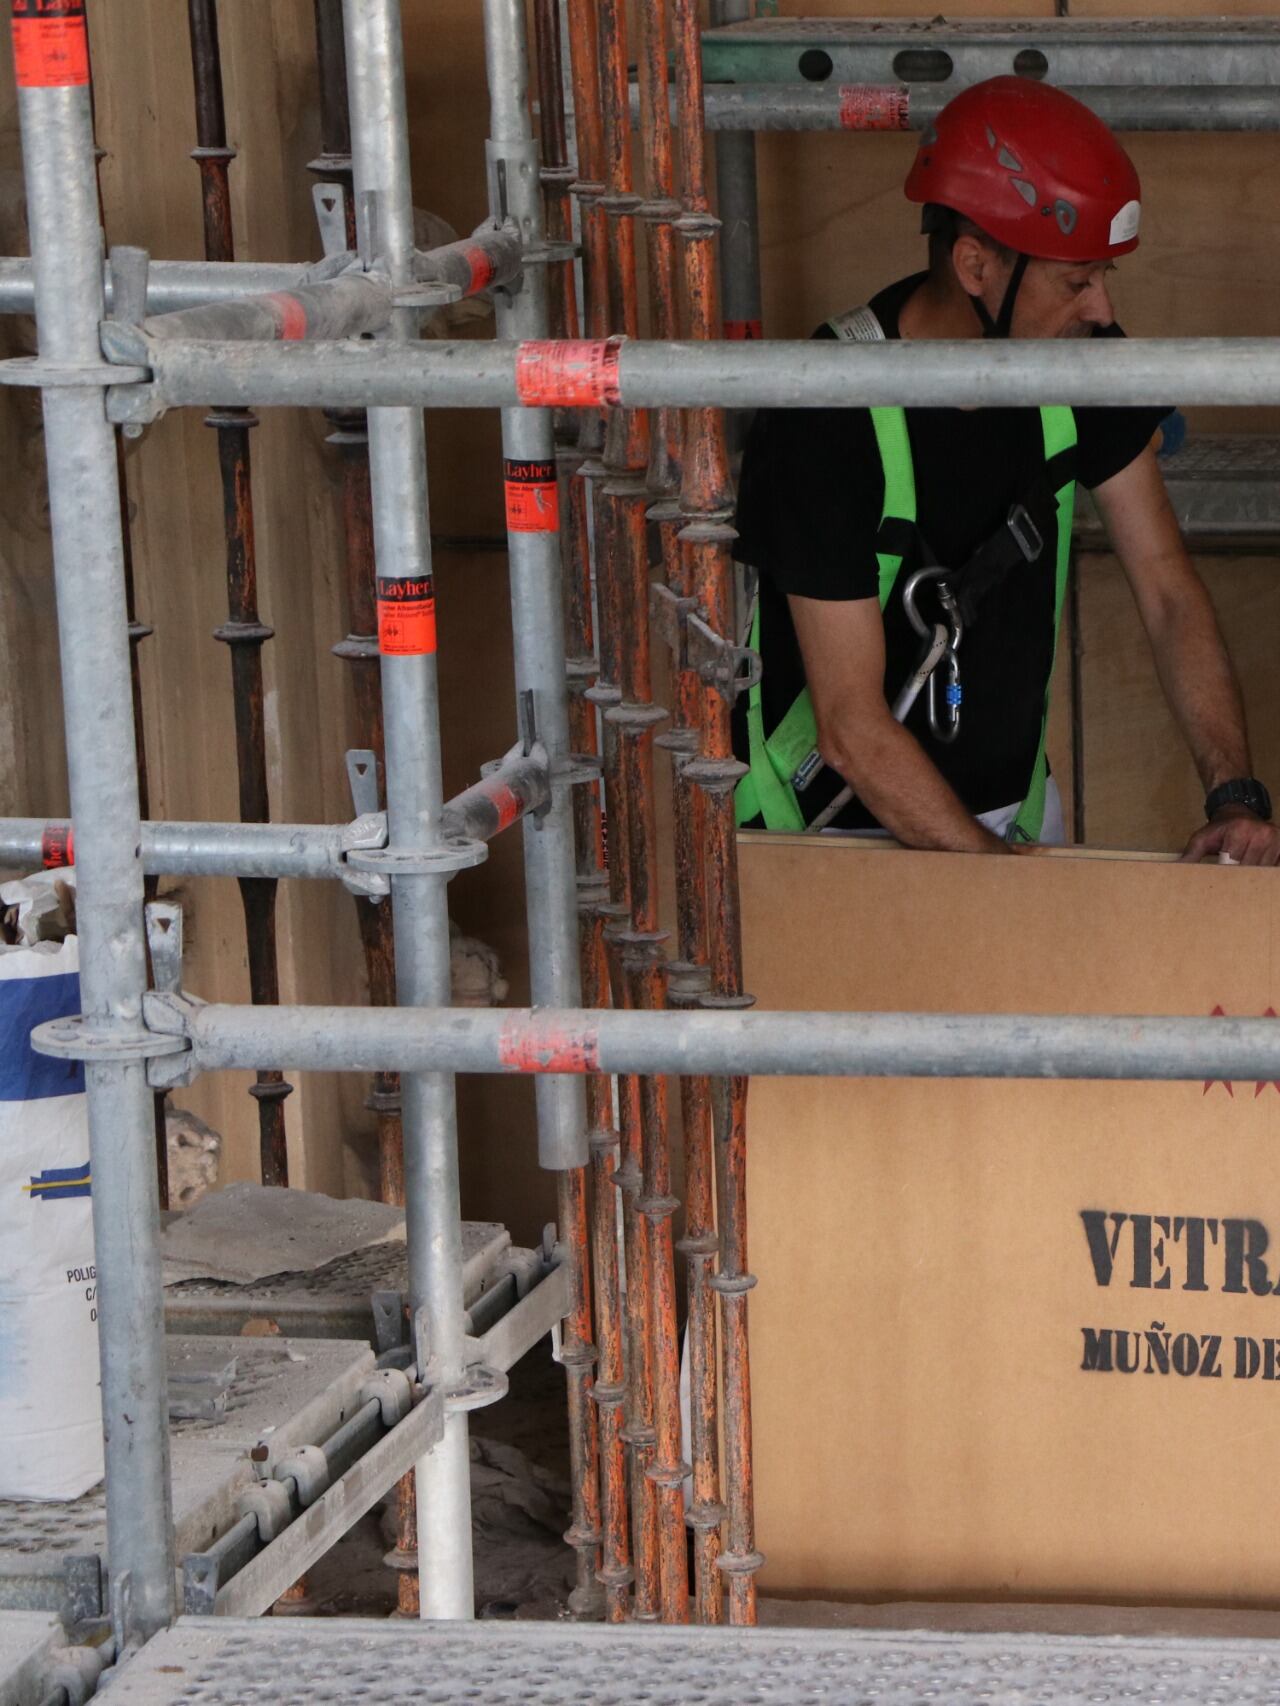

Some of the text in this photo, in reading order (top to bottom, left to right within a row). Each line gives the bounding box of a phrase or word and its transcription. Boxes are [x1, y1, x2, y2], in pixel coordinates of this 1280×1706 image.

[507, 462, 552, 480] Layher
[380, 579, 430, 599] Layher
[1080, 1321, 1223, 1377] MUÑOZ
